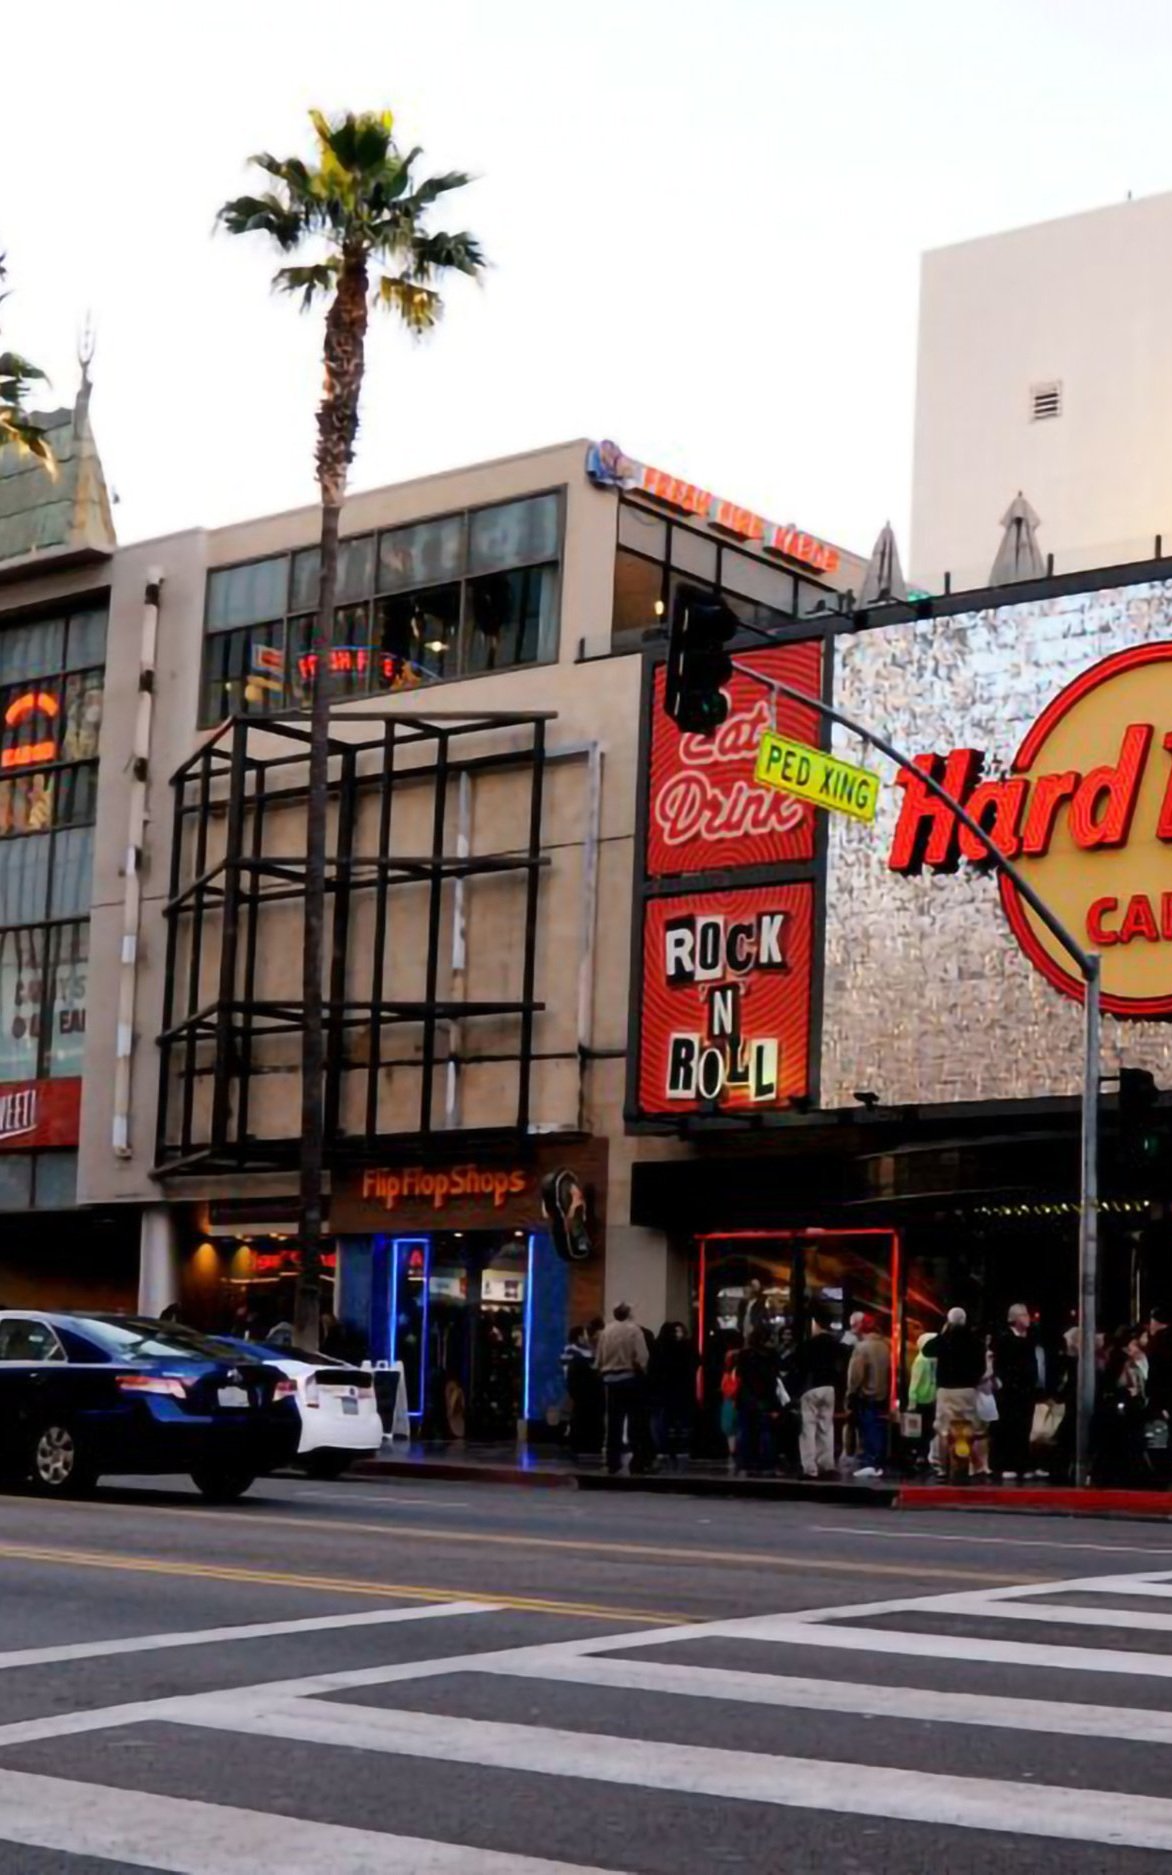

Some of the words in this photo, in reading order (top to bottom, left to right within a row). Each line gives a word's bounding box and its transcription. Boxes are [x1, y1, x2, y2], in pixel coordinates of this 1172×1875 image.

[765, 743, 812, 787] PED
[819, 764, 871, 810] XING
[887, 722, 1155, 873] Hard
[665, 914, 785, 978] ROCK
[667, 1036, 776, 1099] ROLL
